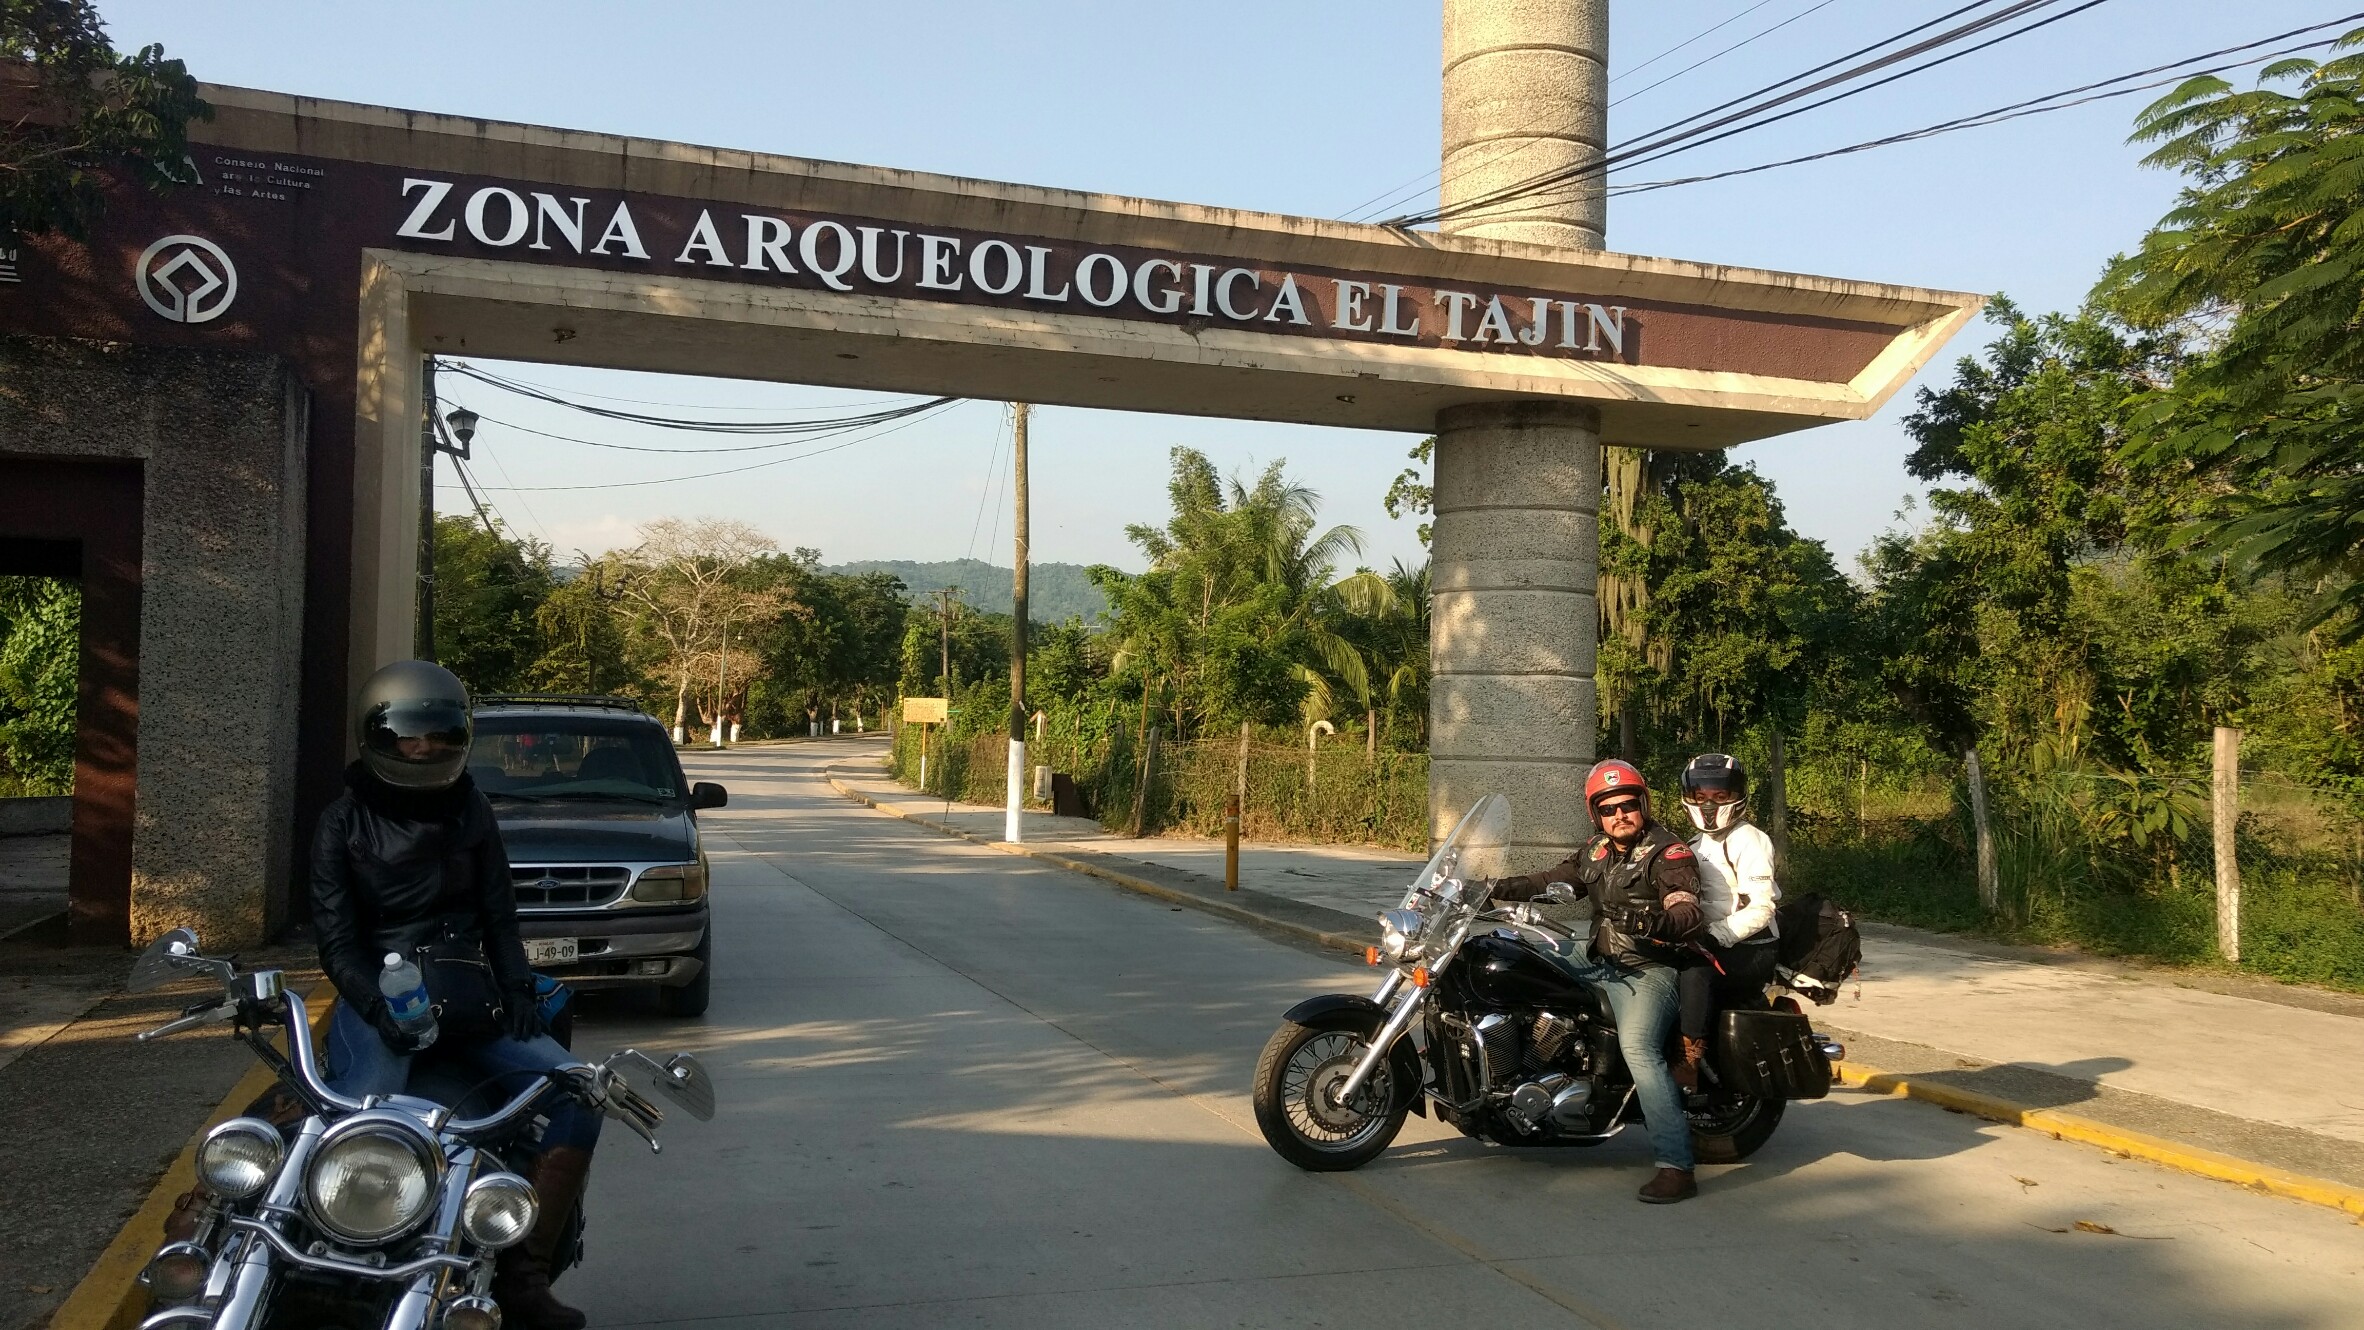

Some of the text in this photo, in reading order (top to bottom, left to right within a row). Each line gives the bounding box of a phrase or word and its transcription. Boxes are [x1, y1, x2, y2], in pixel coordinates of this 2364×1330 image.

[274, 162, 325, 177] Nacional
[267, 175, 311, 189] Cultura
[214, 185, 285, 201] y las Artes
[396, 178, 1627, 354] ZONA ARQUEOLOGICA EL TAJIN
[526, 945, 575, 961] LJ-49-09
